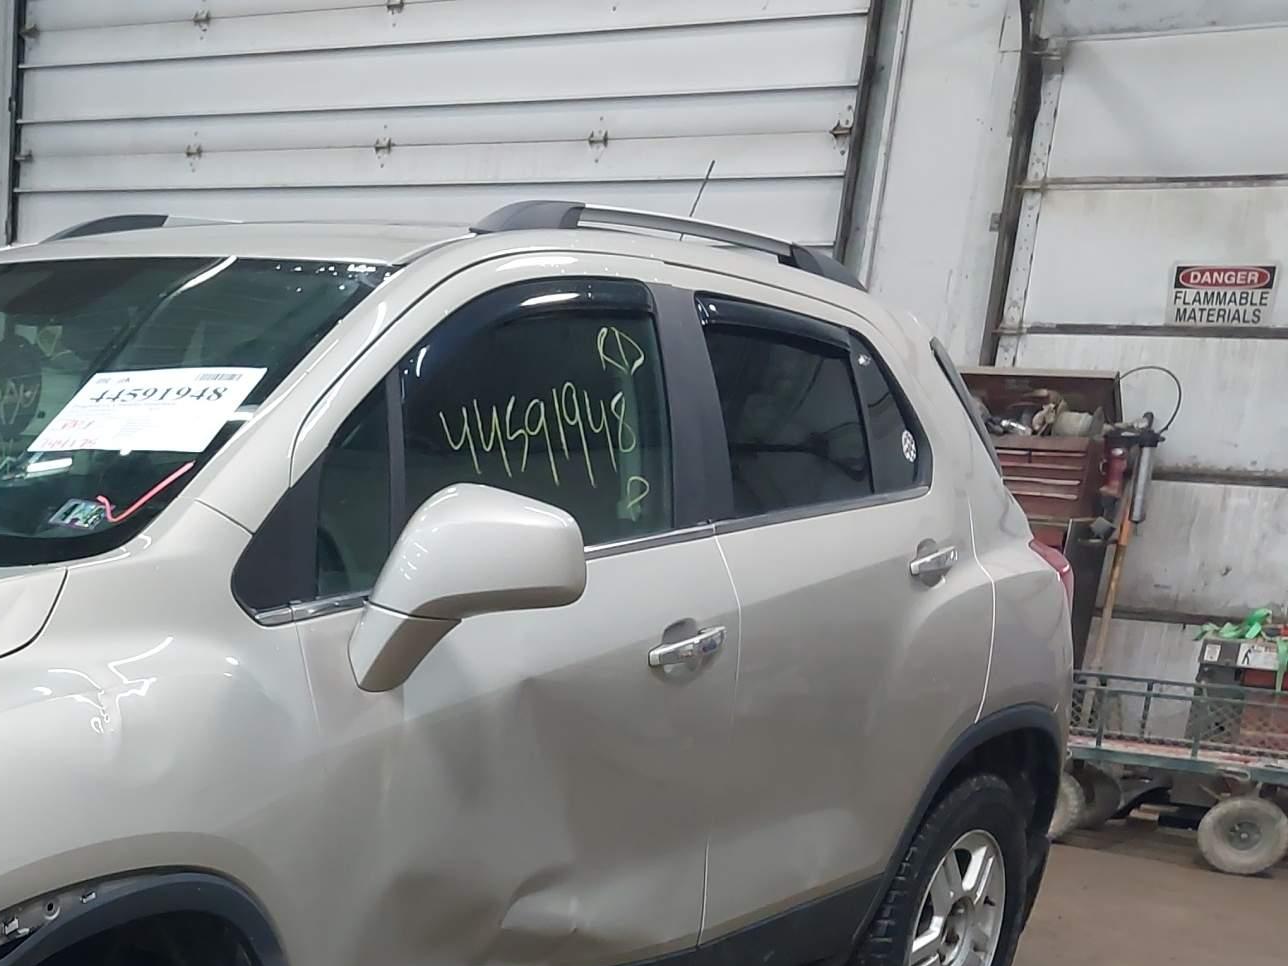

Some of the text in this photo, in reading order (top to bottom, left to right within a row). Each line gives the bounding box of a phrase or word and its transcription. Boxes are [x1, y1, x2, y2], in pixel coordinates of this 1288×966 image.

[1190, 271, 1259, 284] DANGER
[1174, 291, 1269, 306] FLAMMABLE
[1175, 308, 1262, 324] MATERIALS
[90, 386, 228, 403] 44591948
[439, 382, 636, 488] 44591948
